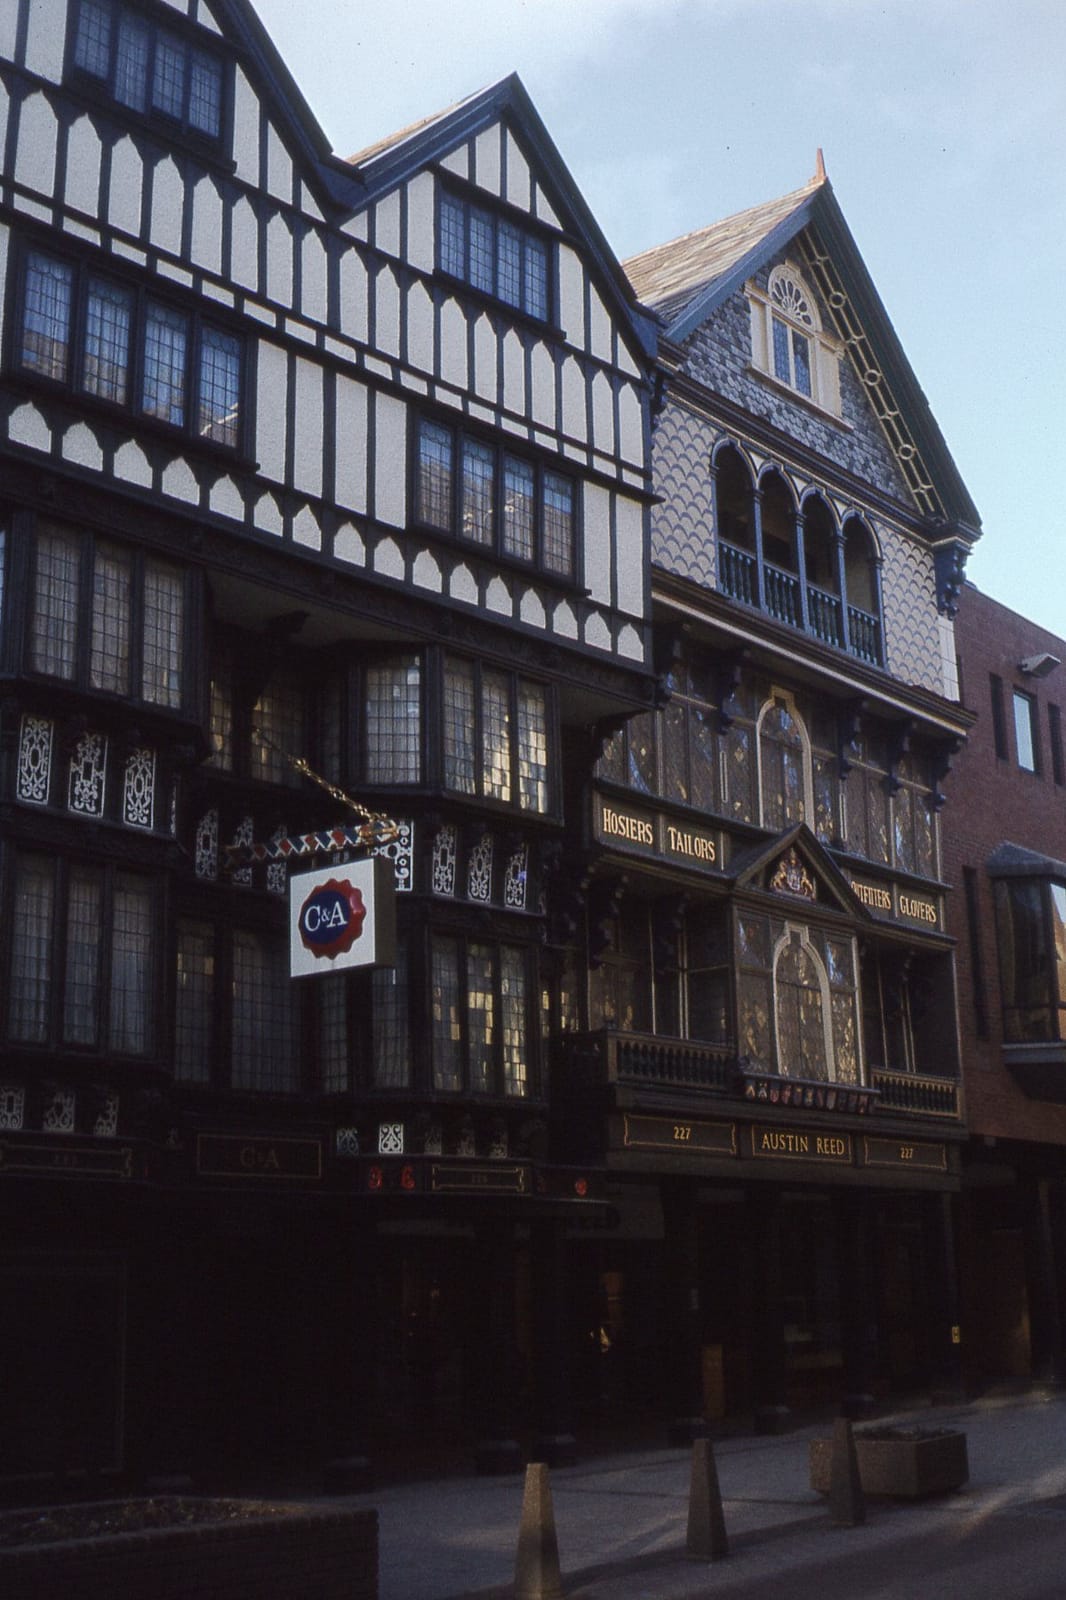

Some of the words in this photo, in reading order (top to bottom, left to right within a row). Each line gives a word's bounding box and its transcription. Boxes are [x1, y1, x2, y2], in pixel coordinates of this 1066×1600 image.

[602, 807, 653, 845] HOSIERS
[667, 826, 716, 862] TAILORS
[304, 901, 348, 932] C&A
[899, 895, 937, 923] GLOVERS
[673, 1126, 691, 1140] 227
[761, 1133, 808, 1152] AUSTIN
[816, 1137, 845, 1155] REED
[900, 1147, 913, 1159] 227
